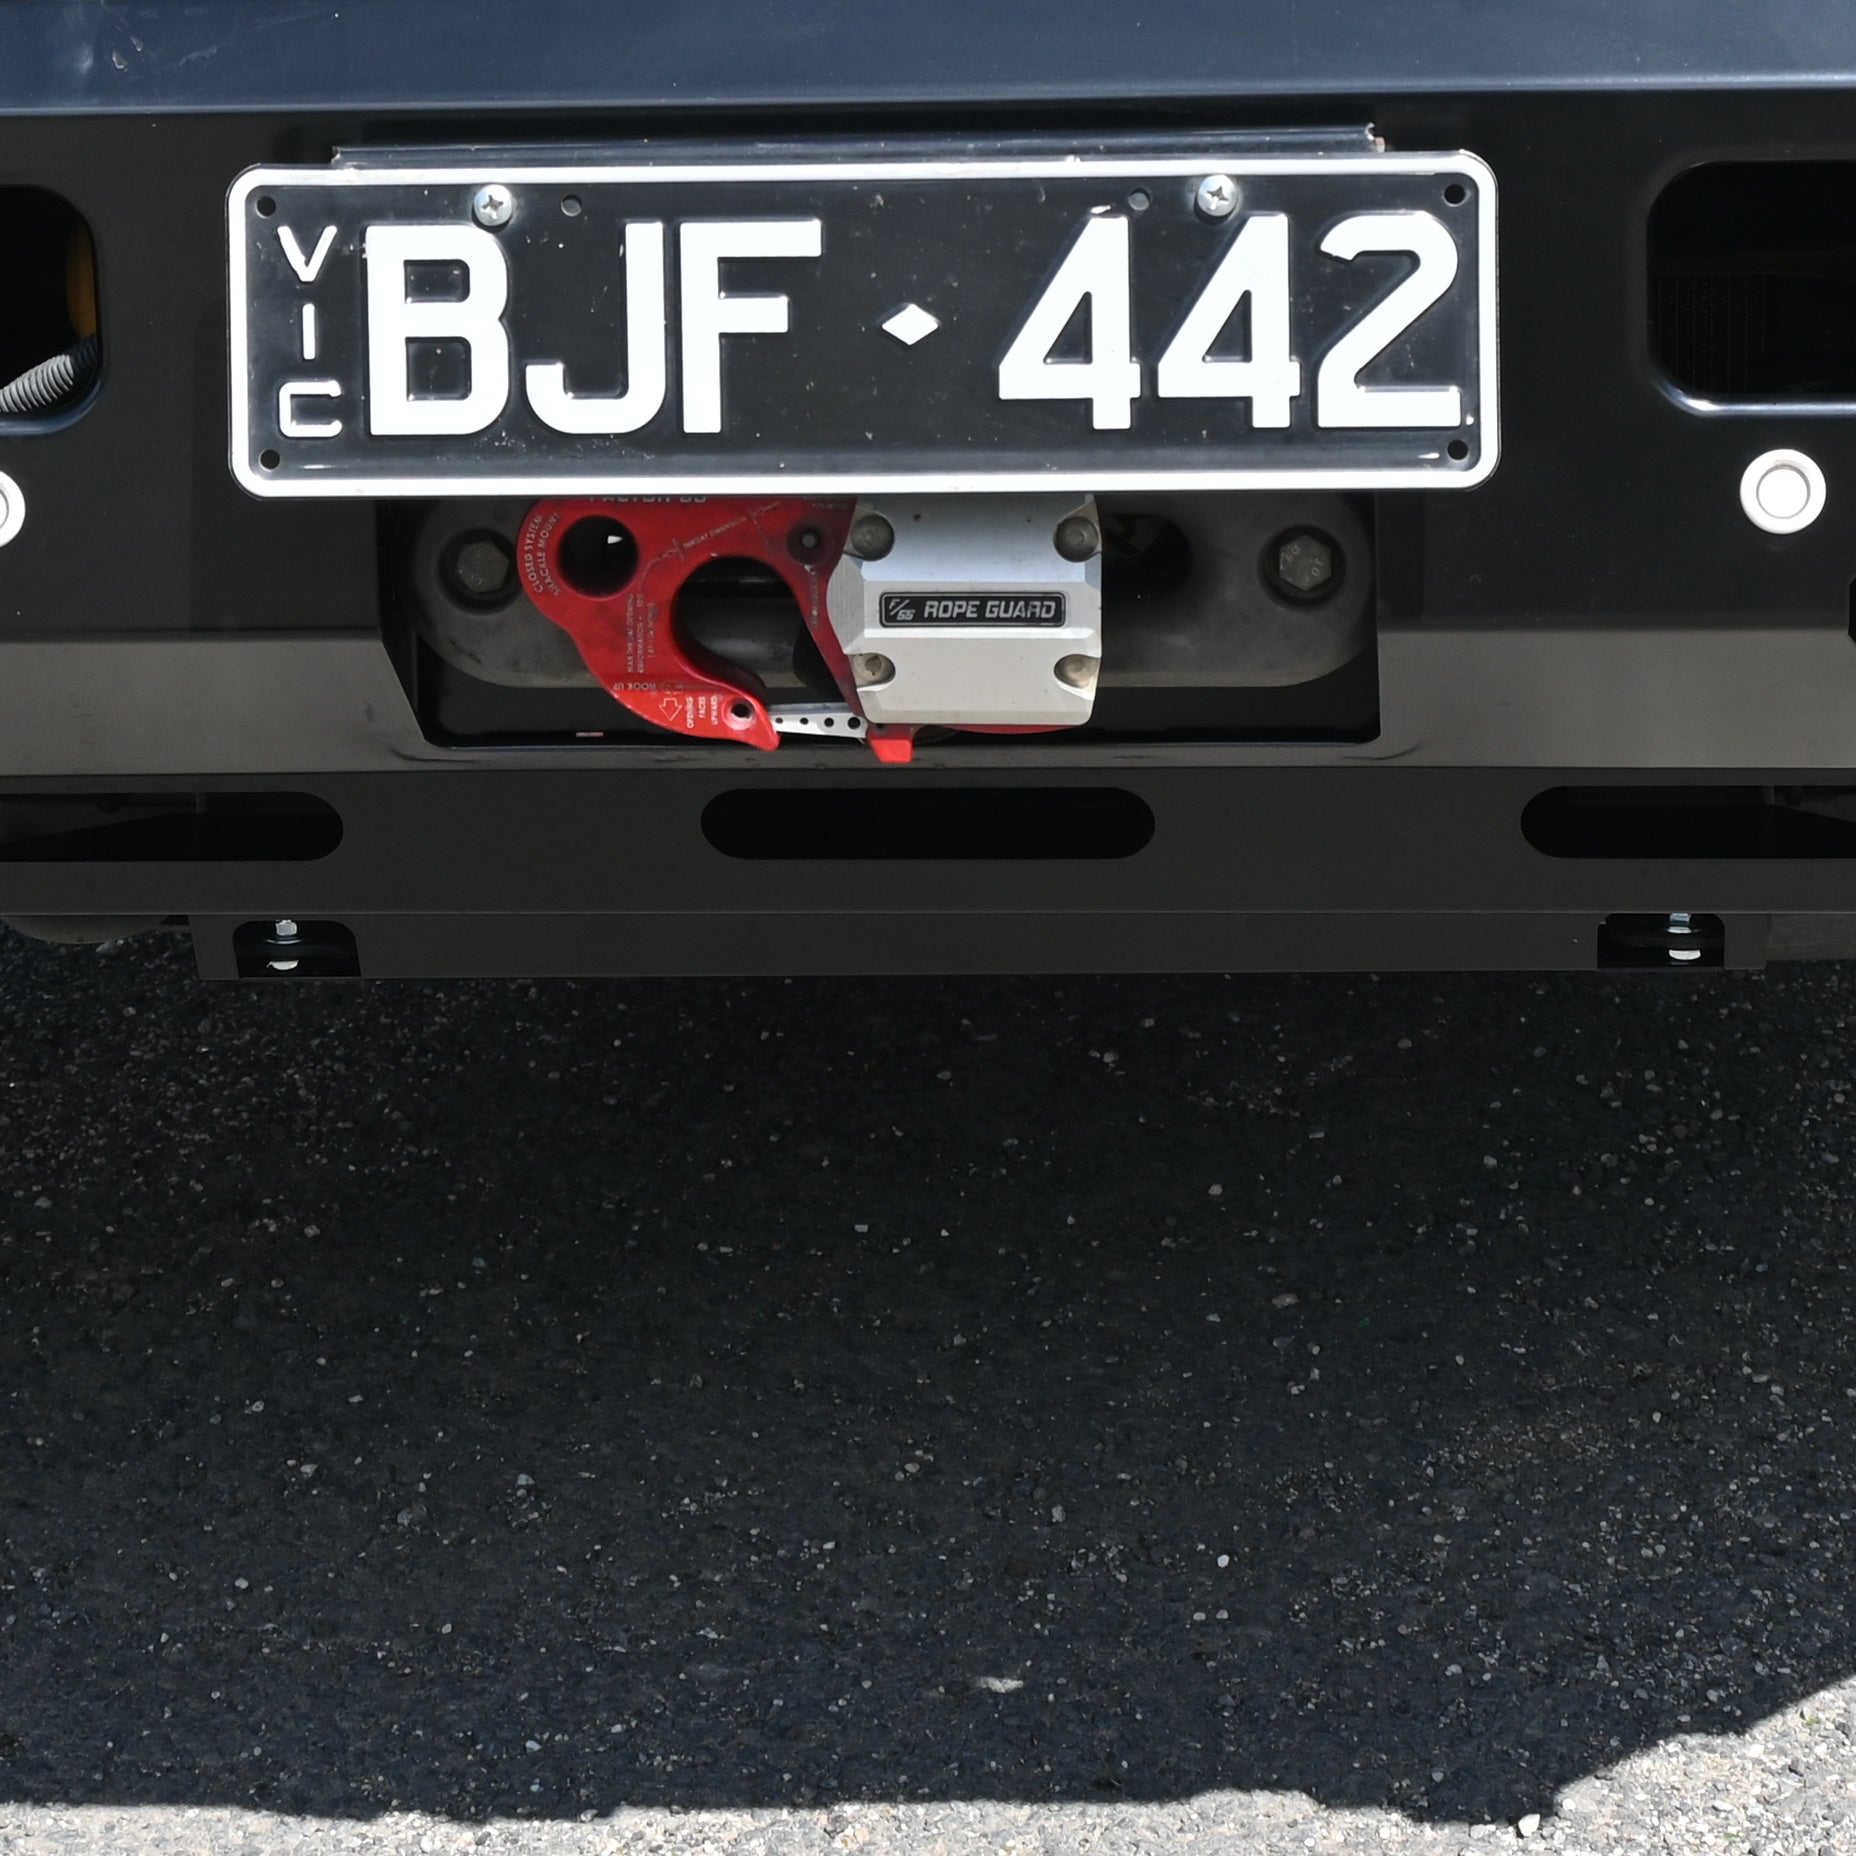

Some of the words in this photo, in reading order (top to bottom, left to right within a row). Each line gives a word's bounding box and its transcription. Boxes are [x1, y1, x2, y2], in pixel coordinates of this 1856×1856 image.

[277, 225, 343, 440] VIC
[364, 218, 824, 437] BJF
[998, 211, 1462, 433] 442
[924, 600, 980, 618] ROPE
[985, 600, 1056, 619] GUARD
